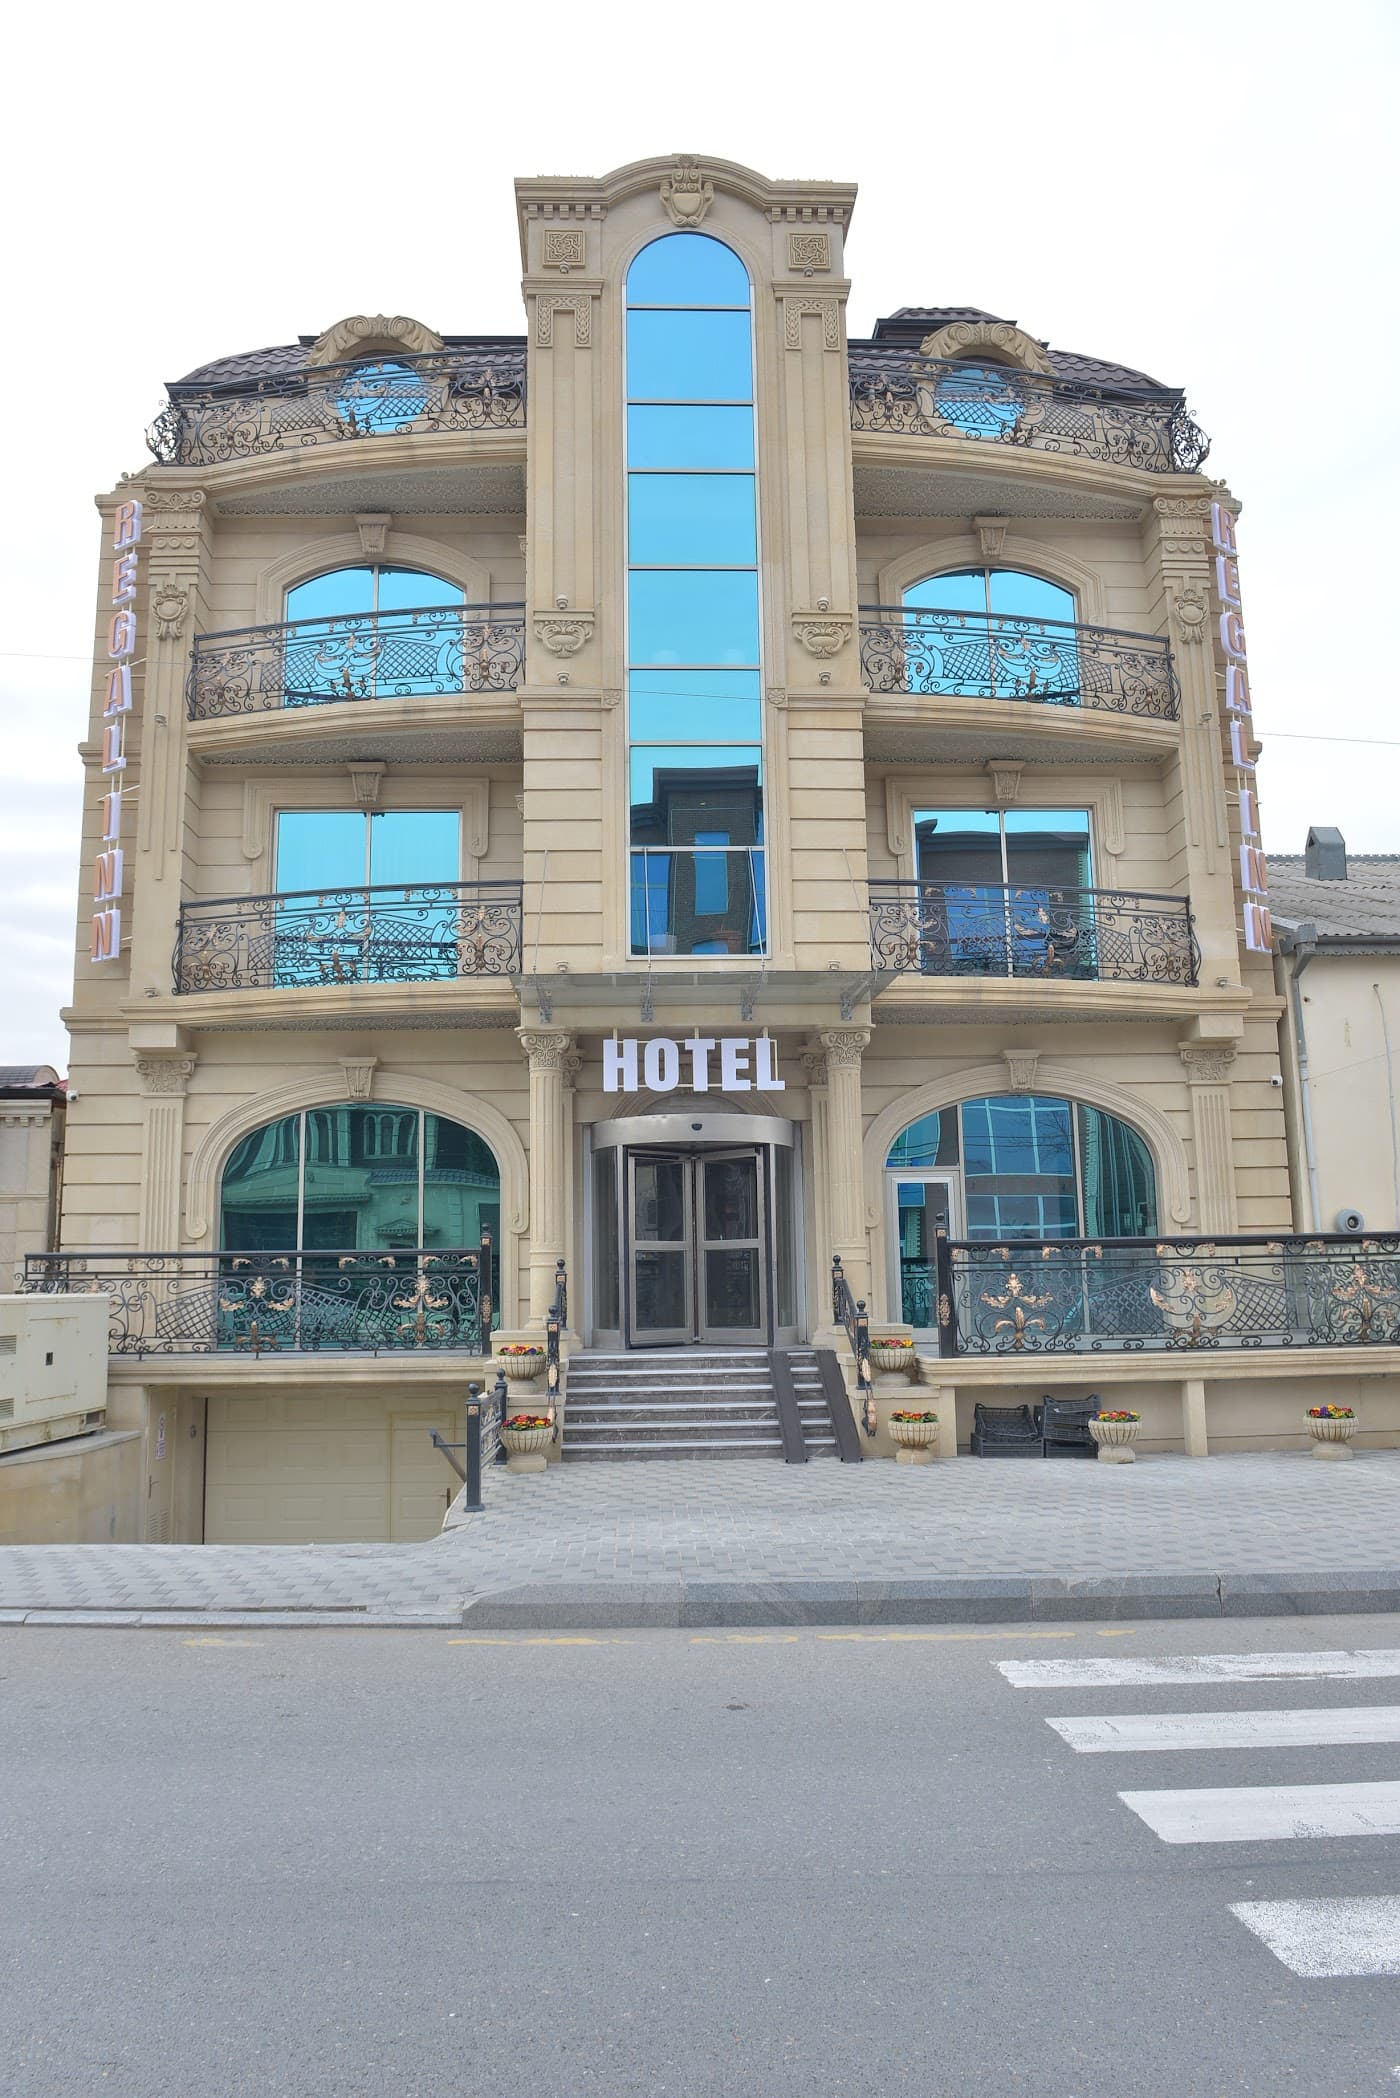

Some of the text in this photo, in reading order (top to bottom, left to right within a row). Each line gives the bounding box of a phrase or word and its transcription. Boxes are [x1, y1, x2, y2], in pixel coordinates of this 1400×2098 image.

[91, 499, 143, 963] REGAL INN
[1210, 502, 1273, 954] REGAL INN
[602, 1037, 786, 1092] HOTEL
